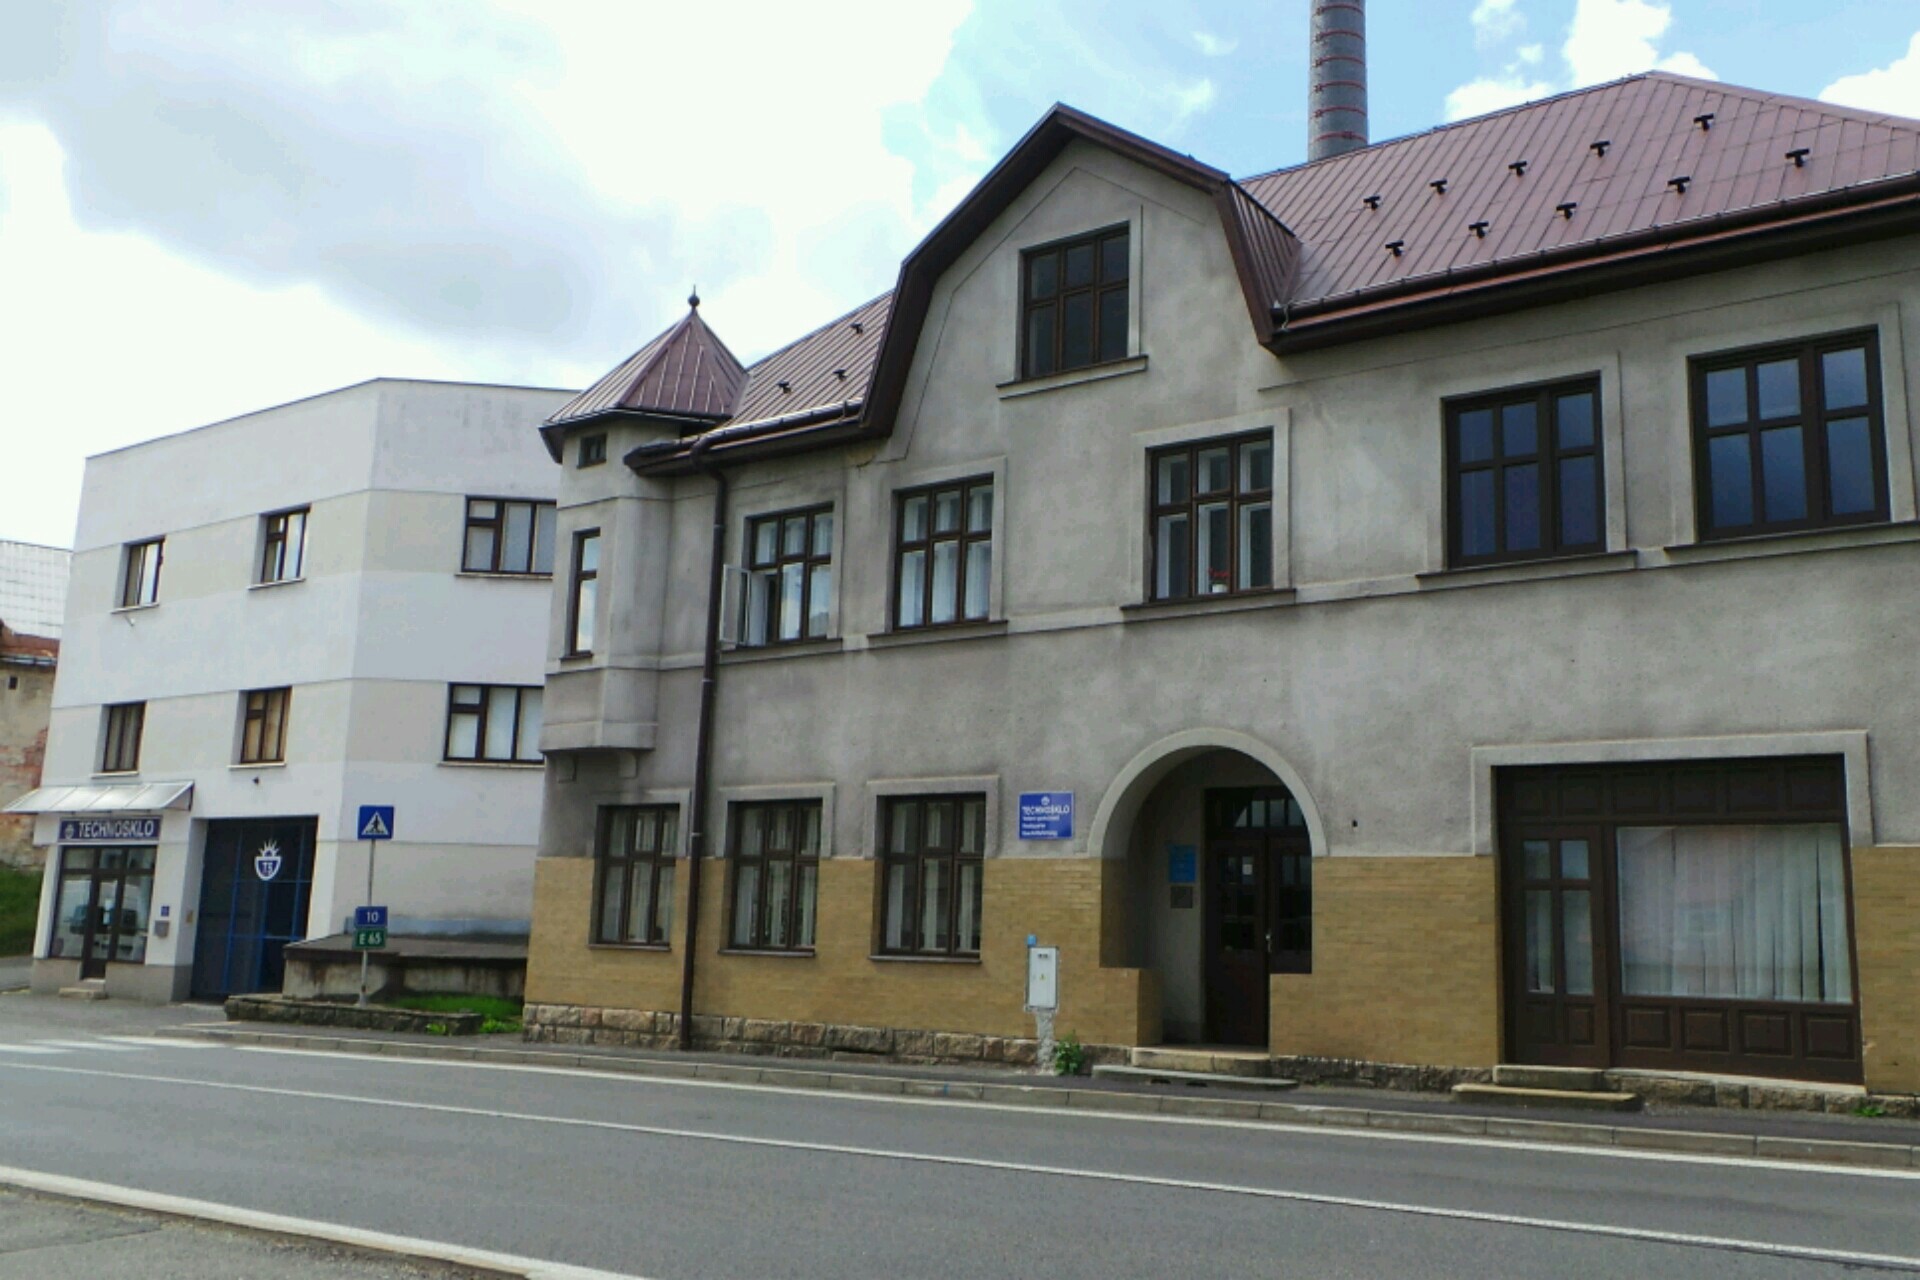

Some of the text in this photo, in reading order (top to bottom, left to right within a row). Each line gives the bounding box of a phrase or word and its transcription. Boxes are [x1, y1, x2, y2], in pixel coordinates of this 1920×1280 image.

[78, 820, 154, 838] TECHNOSKLO
[366, 911, 379, 923] 10
[359, 933, 366, 945] E
